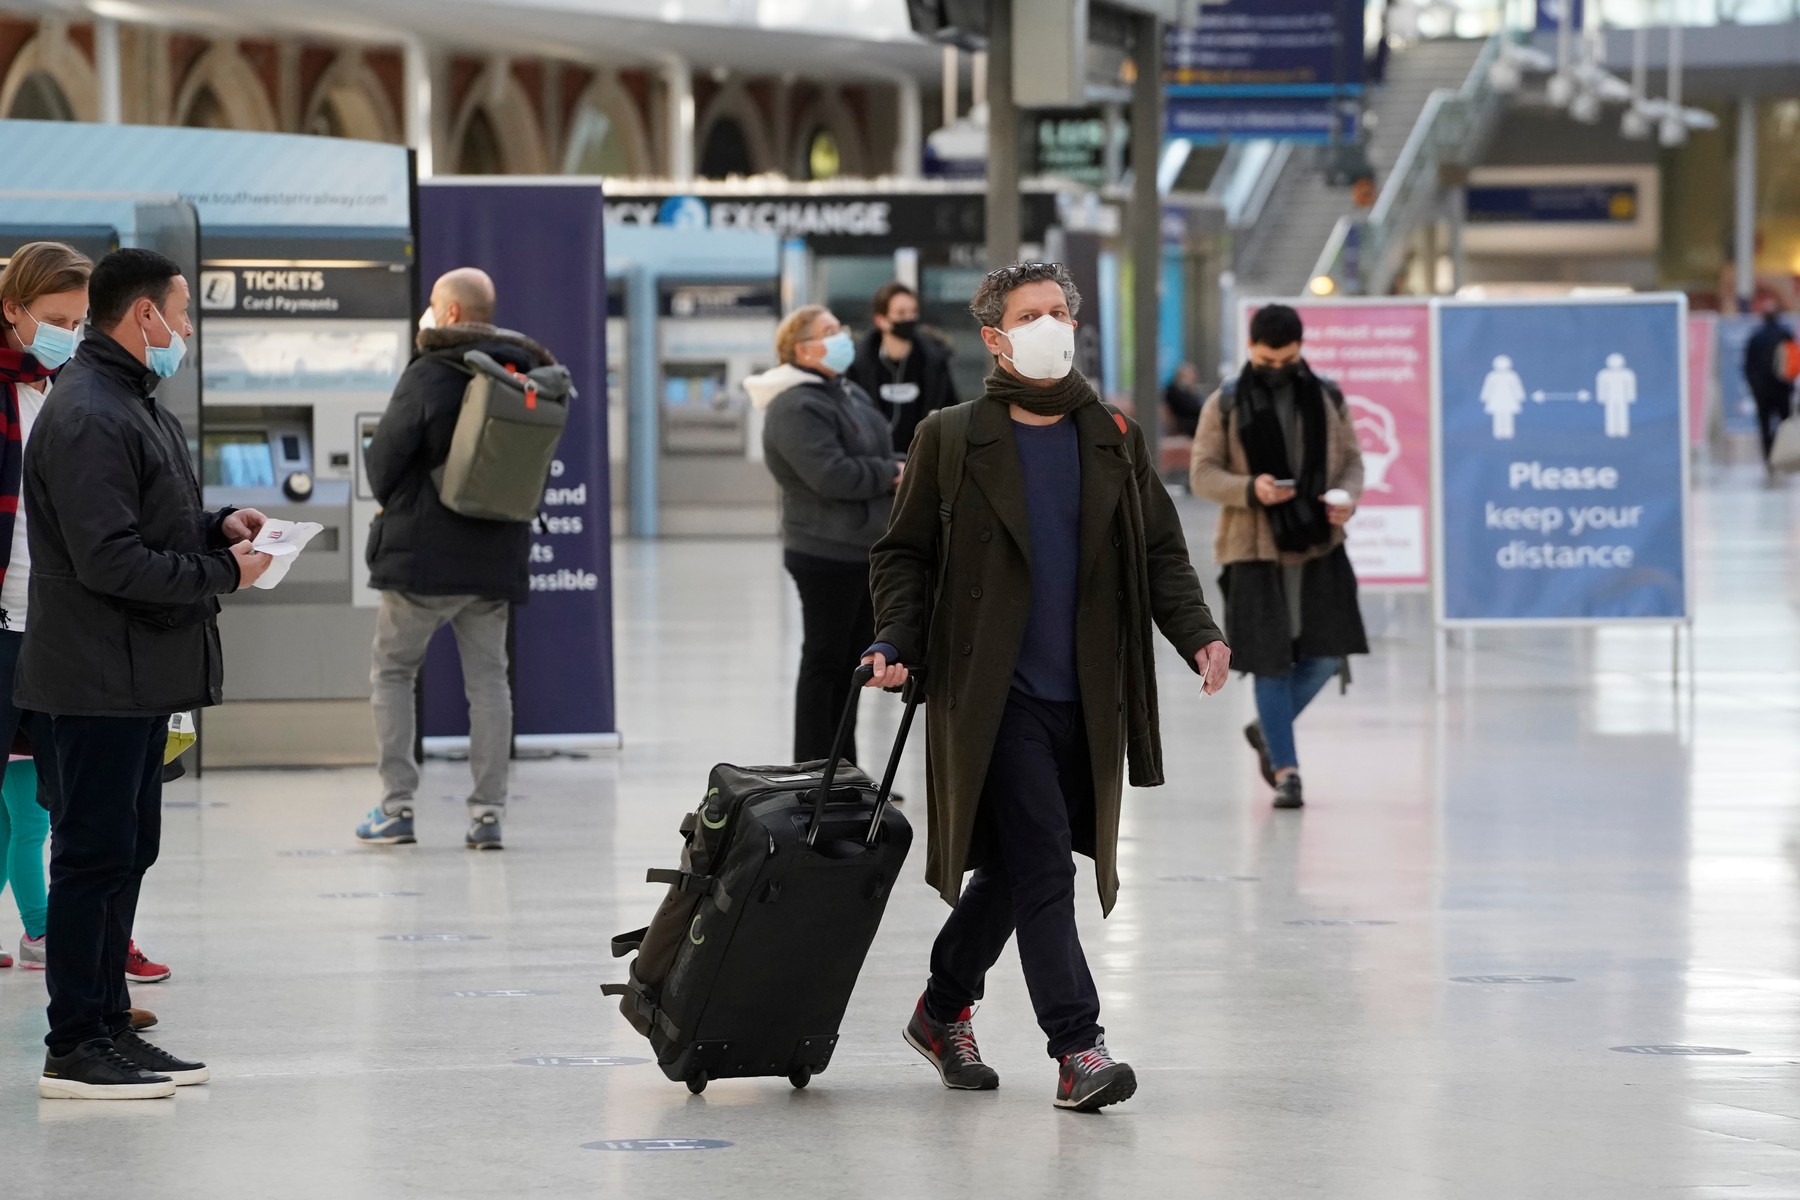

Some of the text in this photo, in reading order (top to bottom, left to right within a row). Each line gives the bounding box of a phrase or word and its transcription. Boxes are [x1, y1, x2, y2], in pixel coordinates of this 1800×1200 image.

[709, 202, 891, 235] EXCHANGE
[242, 271, 325, 291] TICKETS
[243, 296, 340, 314] Card Payments
[1508, 461, 1619, 490] Please
[544, 482, 587, 506] and
[1485, 500, 1645, 536] keep your
[1496, 540, 1635, 569] distance
